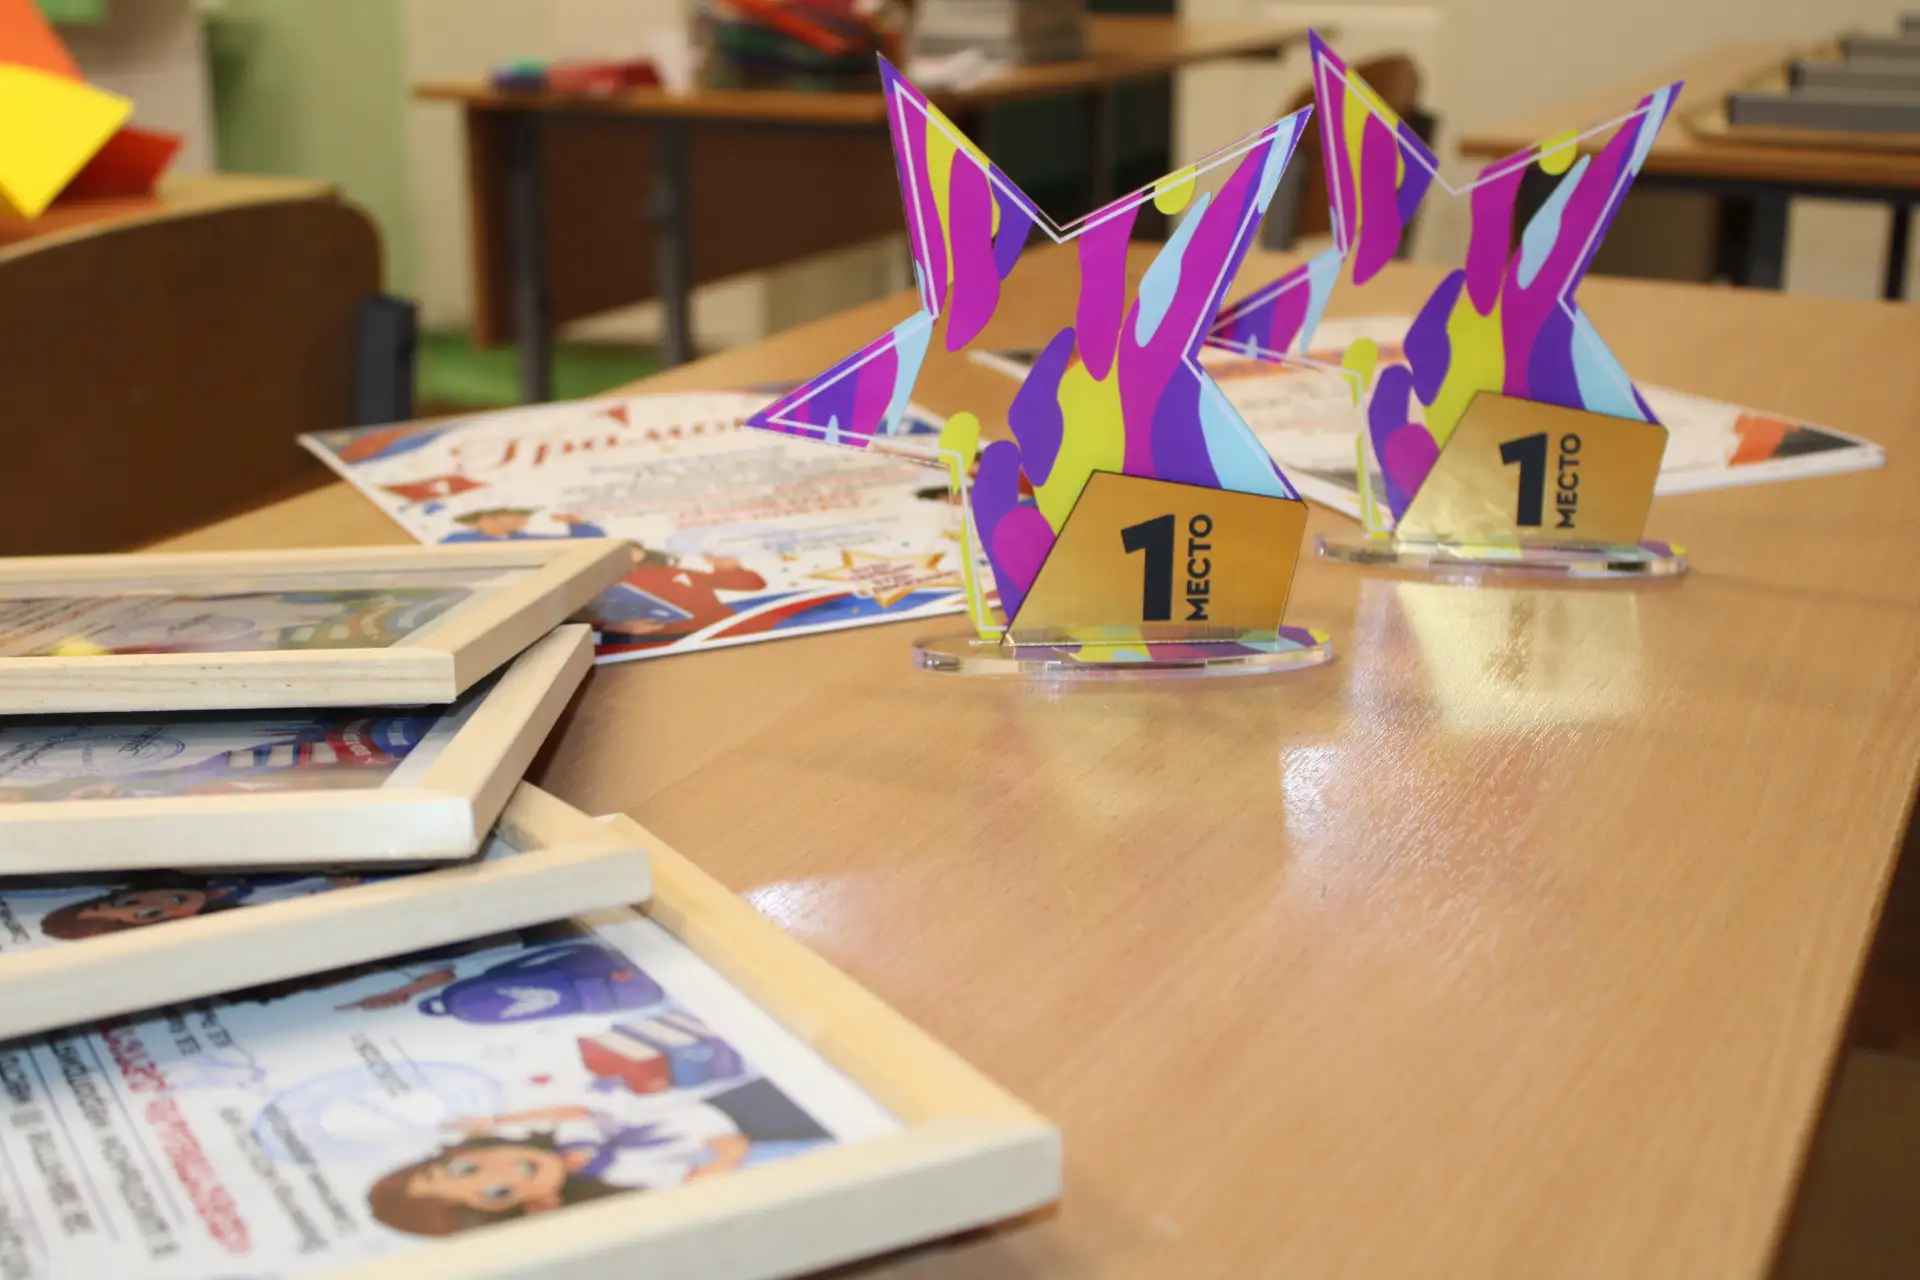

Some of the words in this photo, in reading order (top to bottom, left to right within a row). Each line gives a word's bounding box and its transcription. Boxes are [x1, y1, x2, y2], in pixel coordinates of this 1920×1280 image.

[1500, 432, 1547, 527] 1
[1555, 433, 1581, 529] МЕСТО
[1121, 514, 1175, 621] 1
[1185, 514, 1213, 621] МЕСТО
